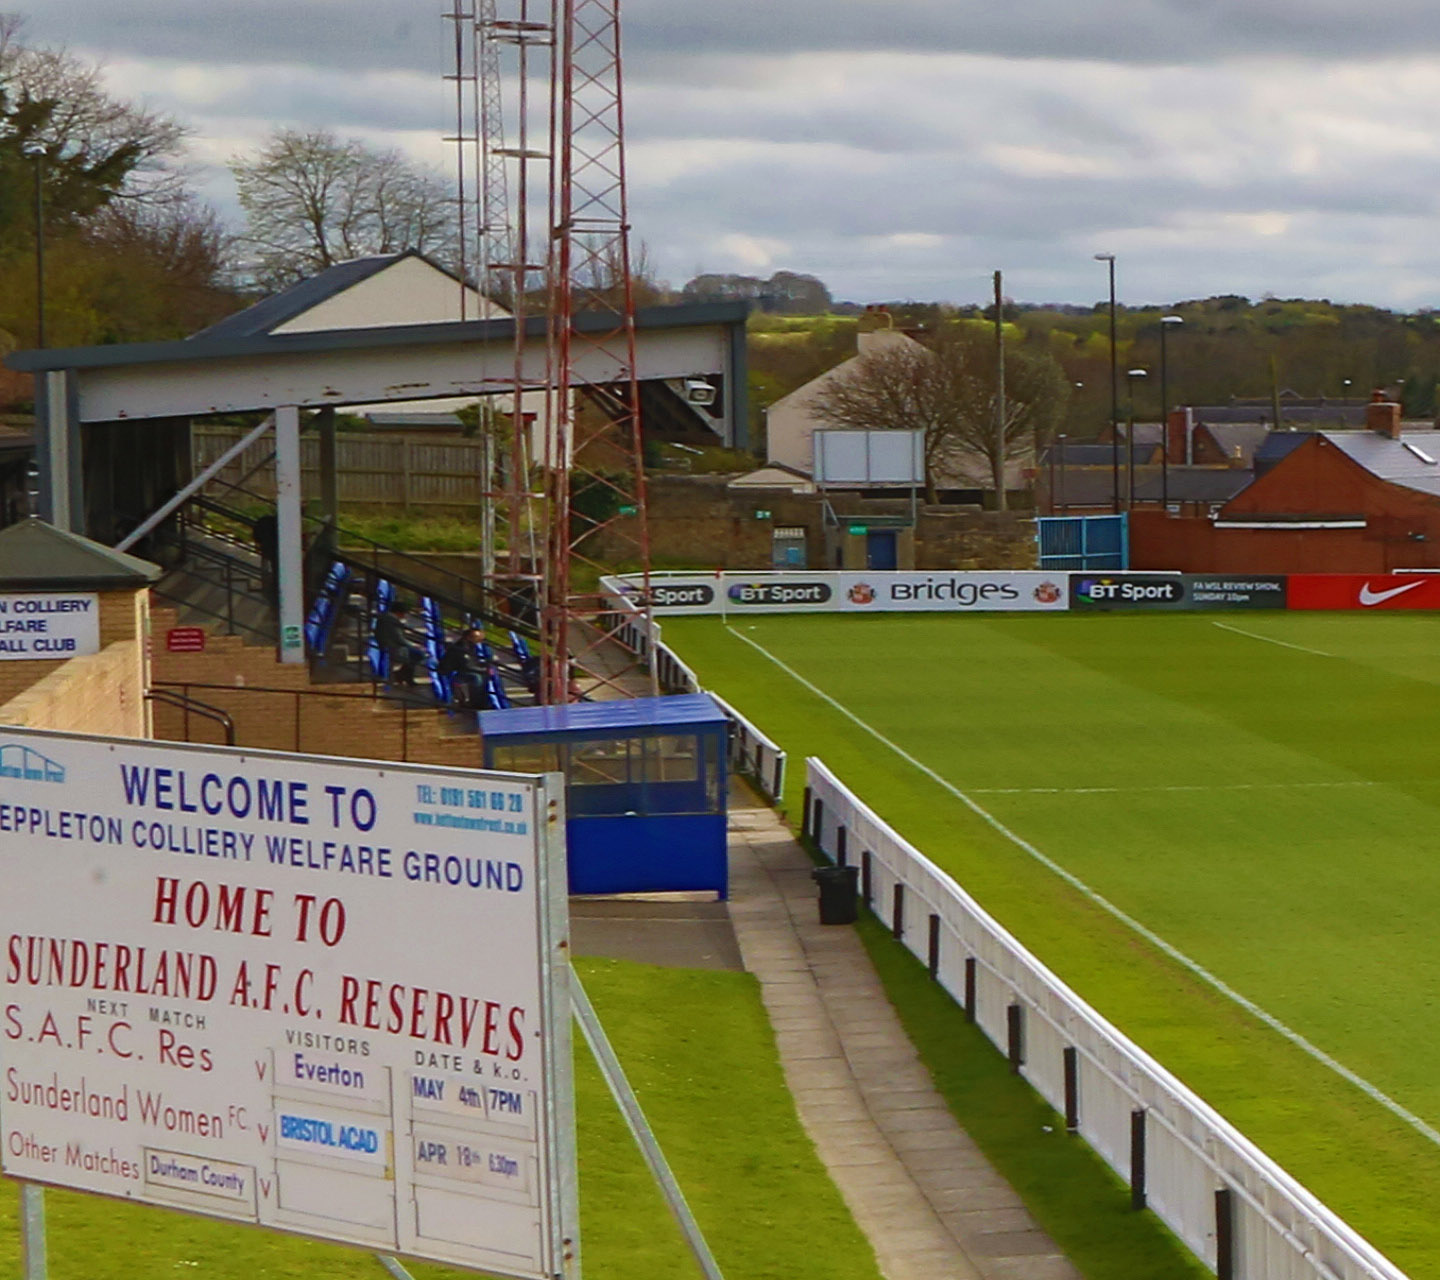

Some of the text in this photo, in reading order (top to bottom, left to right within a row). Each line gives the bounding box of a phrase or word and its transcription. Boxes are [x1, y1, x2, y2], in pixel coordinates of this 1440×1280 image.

[14, 599, 91, 613] COLLIERY
[655, 588, 704, 604] Sport
[740, 586, 821, 602] BT Sport
[891, 578, 1019, 606] Bridges
[1089, 583, 1173, 601] BT Sport
[33, 638, 76, 651] CLUB
[120, 764, 377, 831] WELCOME TO
[417, 784, 436, 804] TEL:
[0, 804, 523, 892] EPPLETON COLLIERY WELFARE GROUND
[153, 876, 346, 947] HOME TO
[6, 934, 526, 1062] SUNDERLAND A.F.C. RESERVES
[87, 998, 206, 1031] NEXT MATCH
[5, 1004, 213, 1072] S.A.F.C. Res
[286, 1029, 370, 1057] VISITORS
[294, 1053, 365, 1089] Everton
[415, 1050, 463, 1072] DATE
[473, 1060, 483, 1074] &
[7, 1067, 128, 1121] Sunderland
[137, 1089, 223, 1138] Women
[413, 1076, 445, 1101] MAY
[489, 1089, 523, 1114] 7PM
[280, 1115, 378, 1153] BRISTOL ACAD
[9, 1131, 244, 1197] Other Matches Durham County
[418, 1141, 447, 1165] APR
